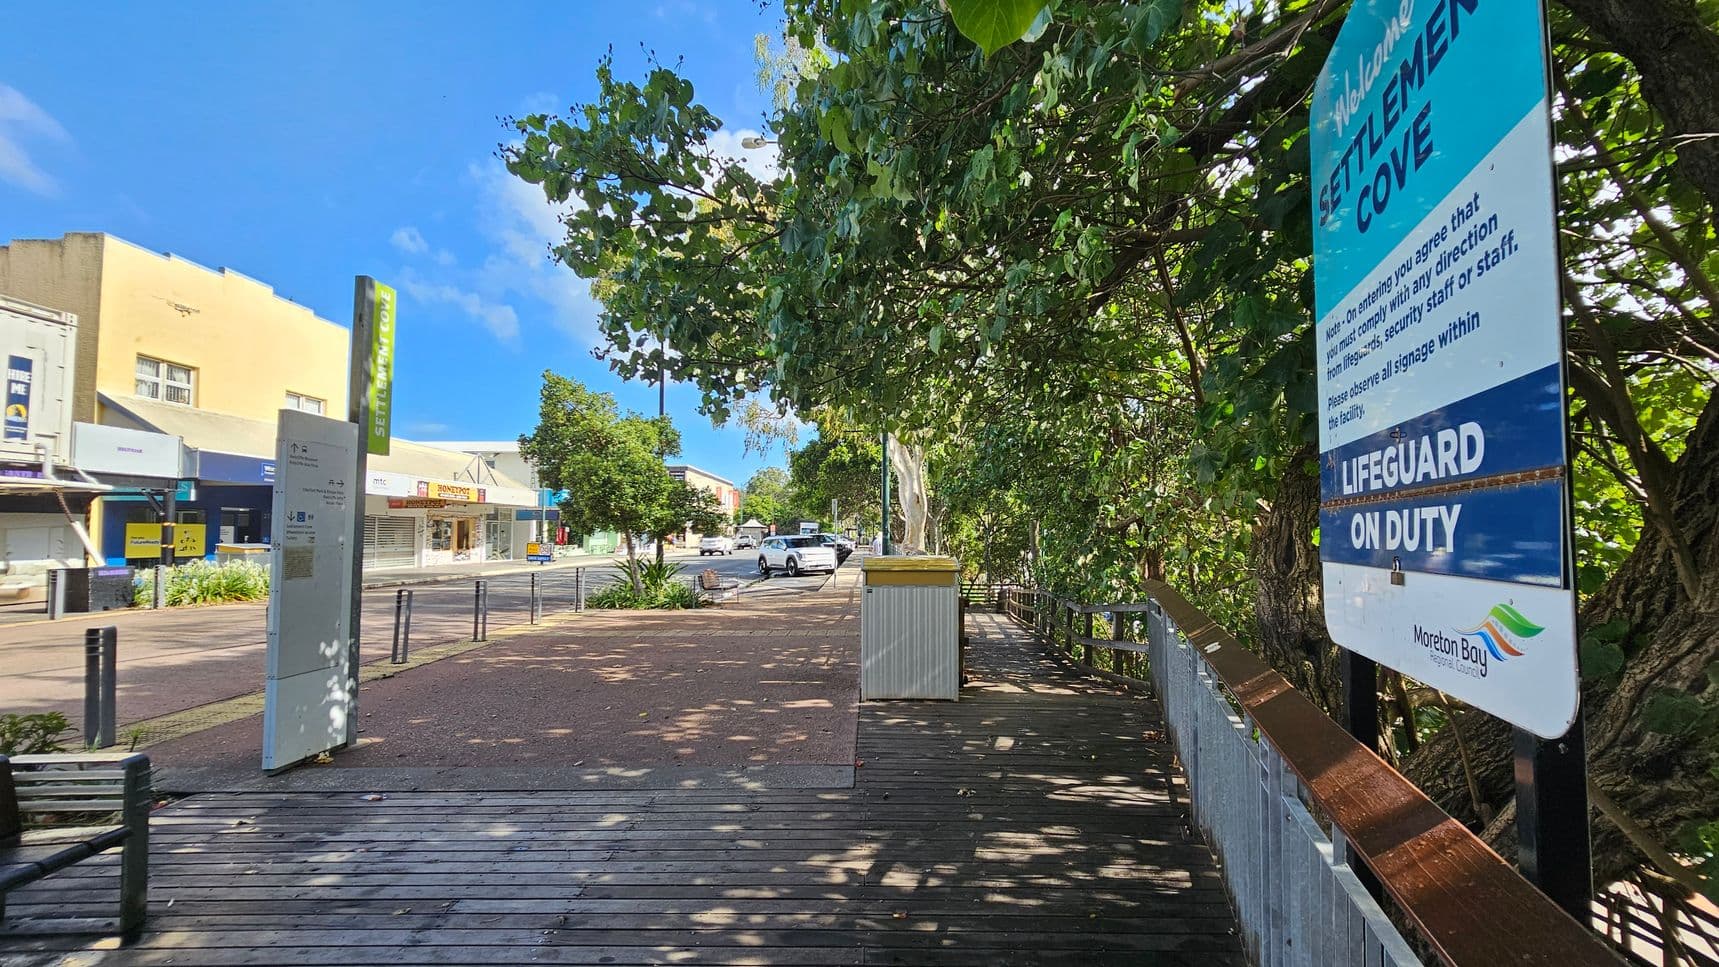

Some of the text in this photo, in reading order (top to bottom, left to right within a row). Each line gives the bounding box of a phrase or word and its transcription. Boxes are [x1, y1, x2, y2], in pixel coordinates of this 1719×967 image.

[1335, 0, 1414, 138] Welcome
[1357, 100, 1433, 233] COVE
[1326, 320, 1341, 342] Note
[1346, 306, 1357, 325] On
[1358, 275, 1393, 315] entering
[1394, 255, 1413, 286] you
[1415, 224, 1448, 265] agree
[1450, 191, 1480, 233] that
[1326, 212, 1498, 364] you must comply with any direction
[1327, 229, 1519, 381] from lifeguards, security staff or staff.
[11, 382, 28, 395] ME
[375, 290, 392, 437] SETTLEMENT COVE
[1328, 311, 1481, 411] Please observe all signage within
[1328, 403, 1366, 431] the facility.
[1342, 421, 1485, 495] LIFEGUARD
[437, 484, 470, 495] HONEYPOT
[1351, 504, 1462, 553] ON DUTY
[1414, 624, 1487, 678] Moreton Bay
[1429, 650, 1481, 680] Regional Council
